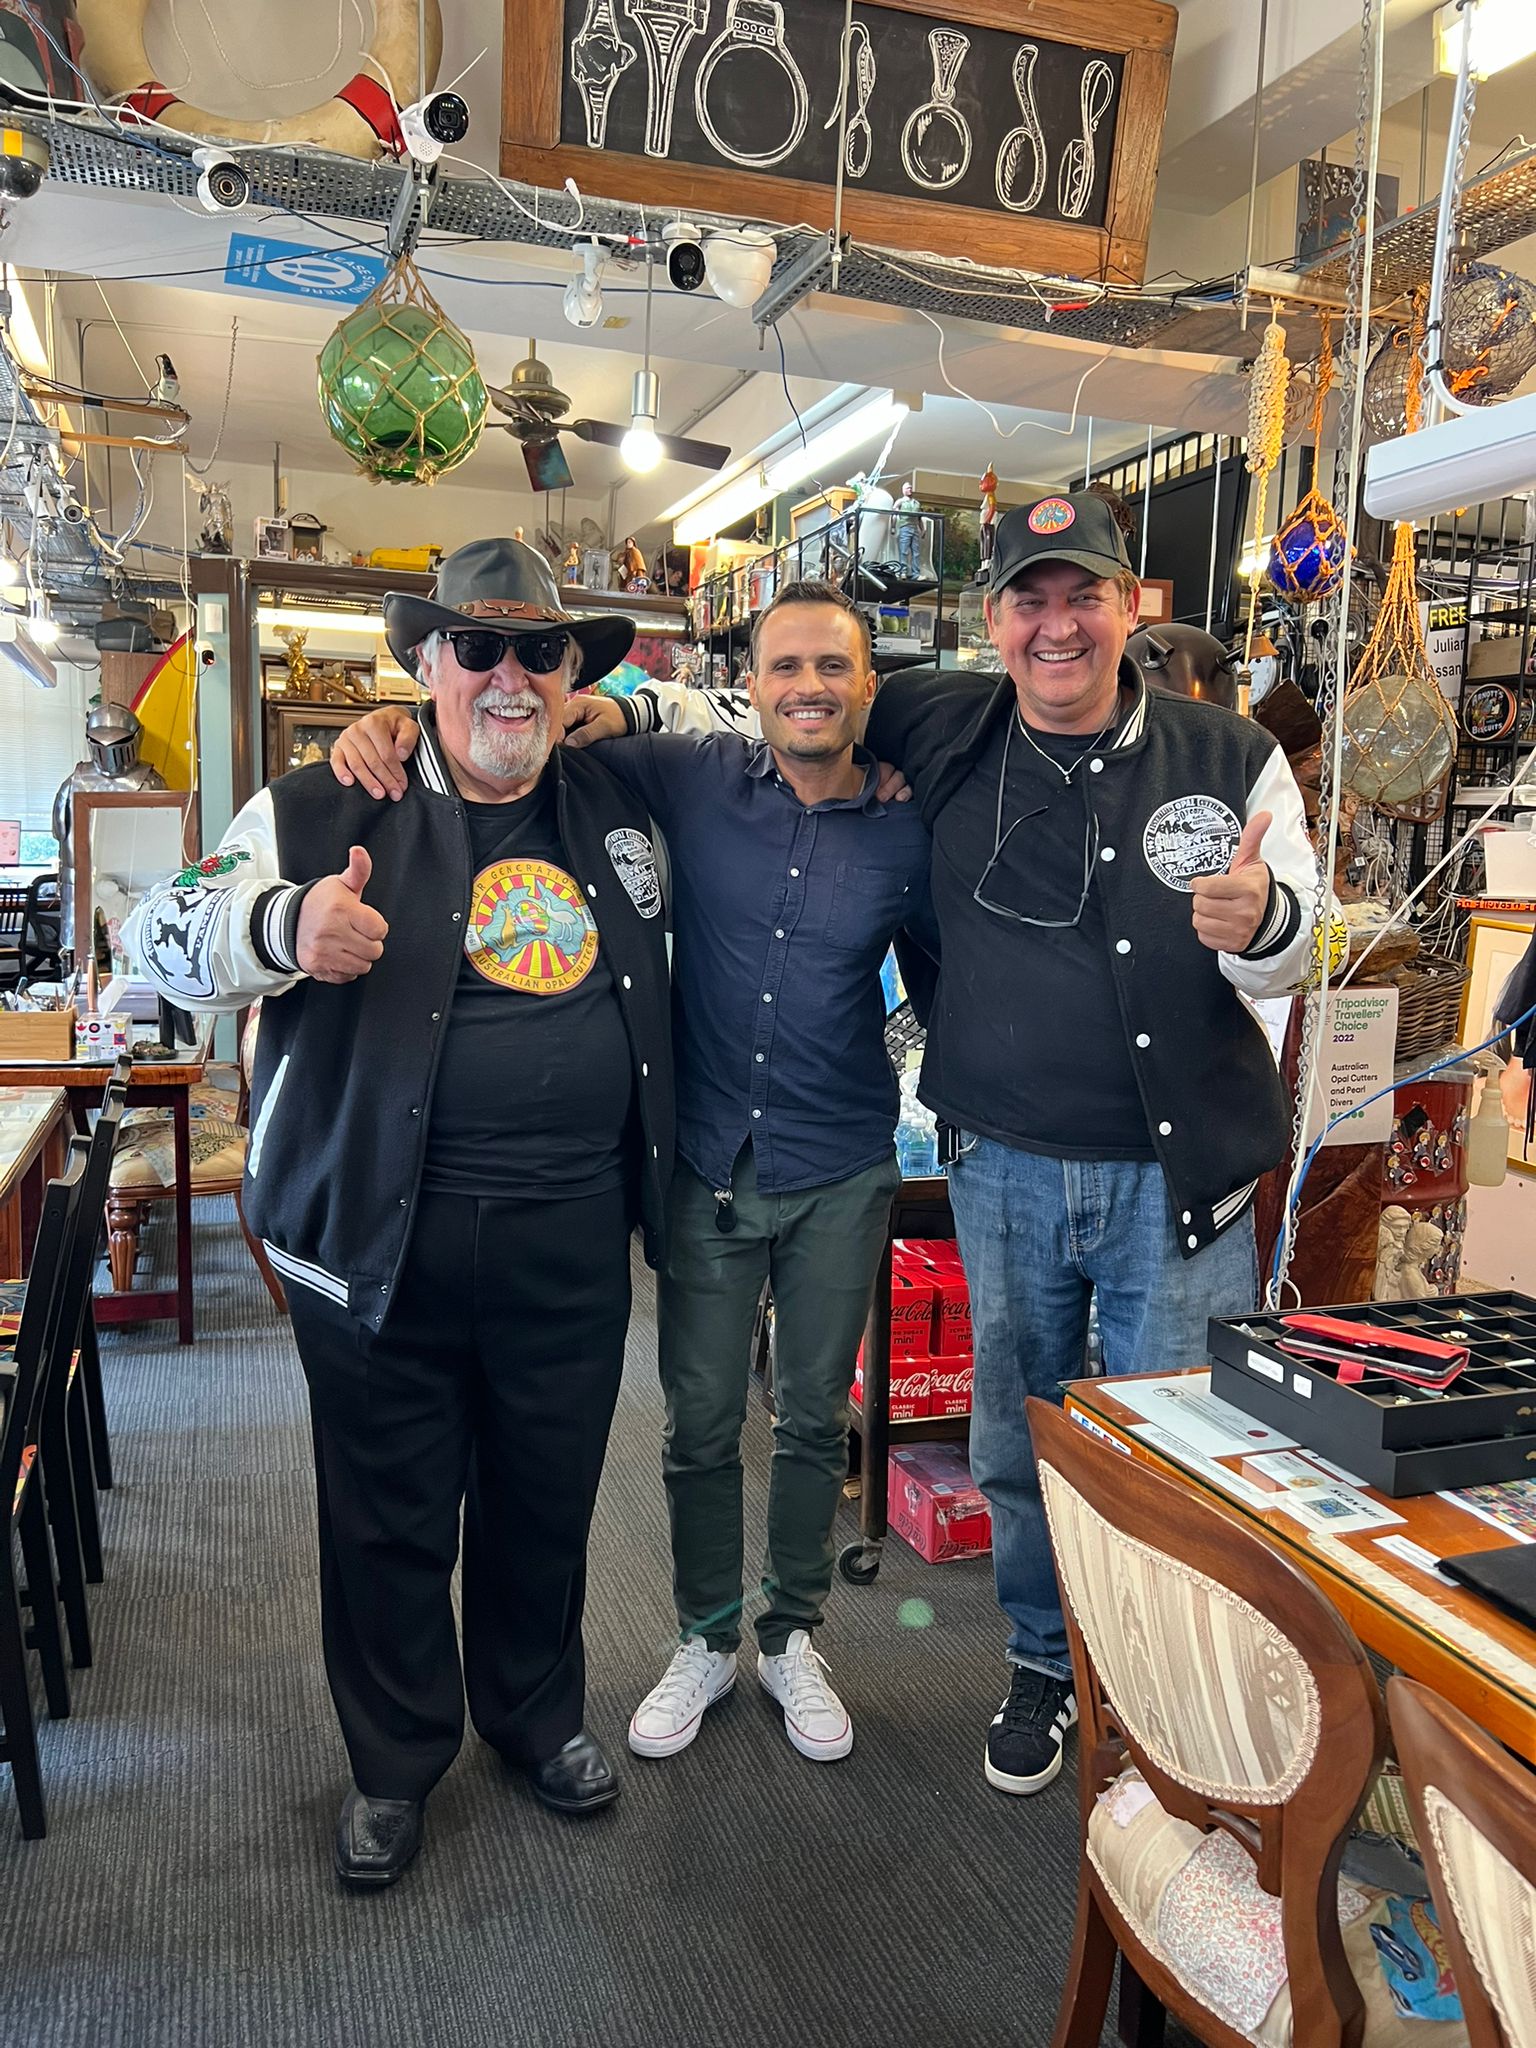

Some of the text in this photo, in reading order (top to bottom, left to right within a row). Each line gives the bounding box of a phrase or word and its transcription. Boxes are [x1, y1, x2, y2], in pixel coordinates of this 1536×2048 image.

[300, 286, 348, 296] HERE
[1429, 605, 1467, 628] FREE
[1174, 798, 1196, 811] OPAL
[1227, 819, 1240, 838] 2017
[473, 934, 597, 990] AUSTRALIAN OPAL CUTTERS
[1335, 997, 1389, 1011] Tripadvisor
[1334, 1008, 1384, 1020] Travellers'
[1333, 1020, 1369, 1031] Choice
[1332, 1034, 1355, 1043] 2022
[1331, 1062, 1369, 1072] Australian
[1330, 1073, 1378, 1086] Opal Cutters
[1330, 1085, 1366, 1096] and Pearl
[1330, 1099, 1353, 1107] Divers
[893, 1336, 914, 1345] mini
[957, 1332, 973, 1341] min
[892, 1409, 914, 1419] mini
[945, 1404, 967, 1414] mini
